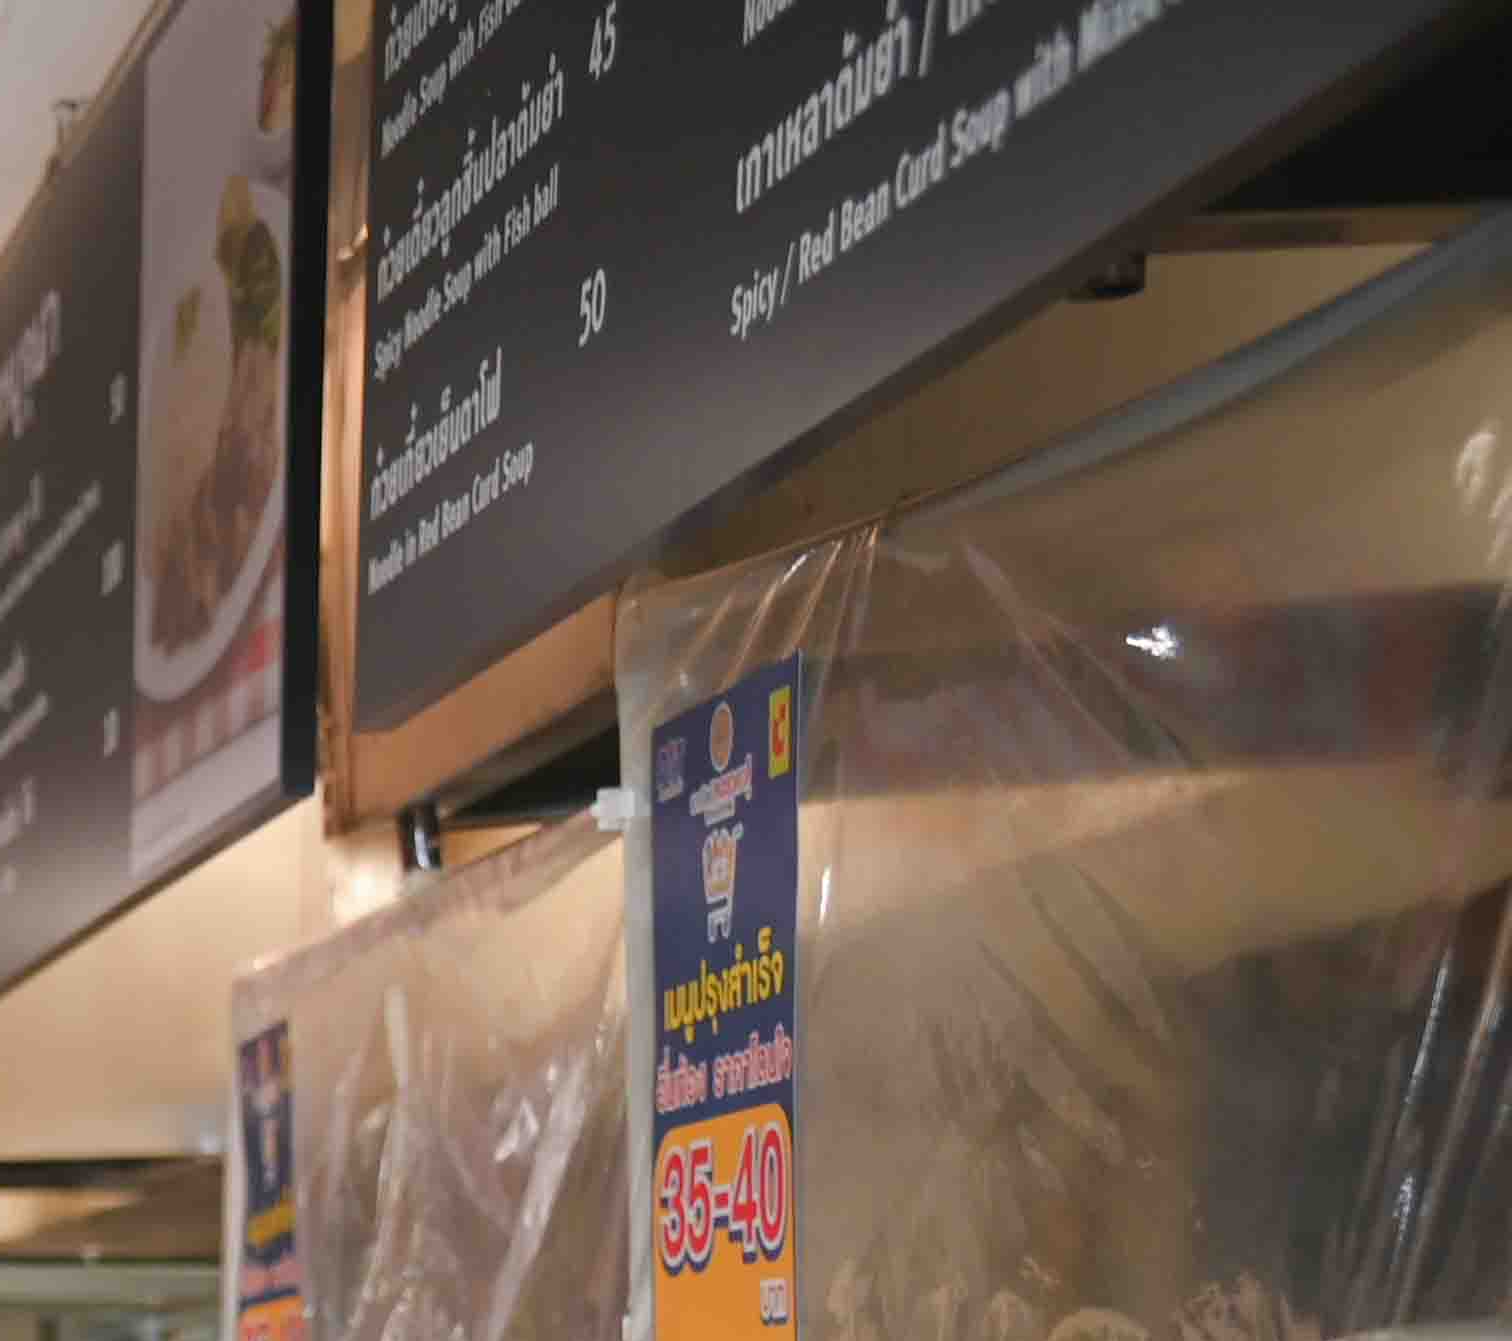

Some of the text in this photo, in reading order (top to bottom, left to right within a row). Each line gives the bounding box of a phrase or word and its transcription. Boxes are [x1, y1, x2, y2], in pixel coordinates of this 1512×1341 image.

[419, 60, 447, 116] Soup
[449, 18, 475, 81] with
[588, 0, 617, 80] 45
[443, 261, 472, 313] Soup
[474, 223, 501, 281] with
[504, 194, 531, 255] Fish
[534, 162, 559, 228] ball
[730, 265, 780, 341] Spicy
[797, 207, 836, 286] Red
[840, 180, 891, 254] Bean
[895, 120, 947, 211] Curd
[950, 88, 1011, 170] Soup
[1014, 26, 1073, 120] with
[578, 267, 607, 349] 50
[418, 504, 440, 558] Red
[441, 491, 470, 540] Bean
[472, 457, 500, 516] Curd
[502, 440, 534, 493] Soup
[664, 926, 784, 1043] เมนูปรุงสำเร็จ
[661, 1119, 791, 1275] 35-40
